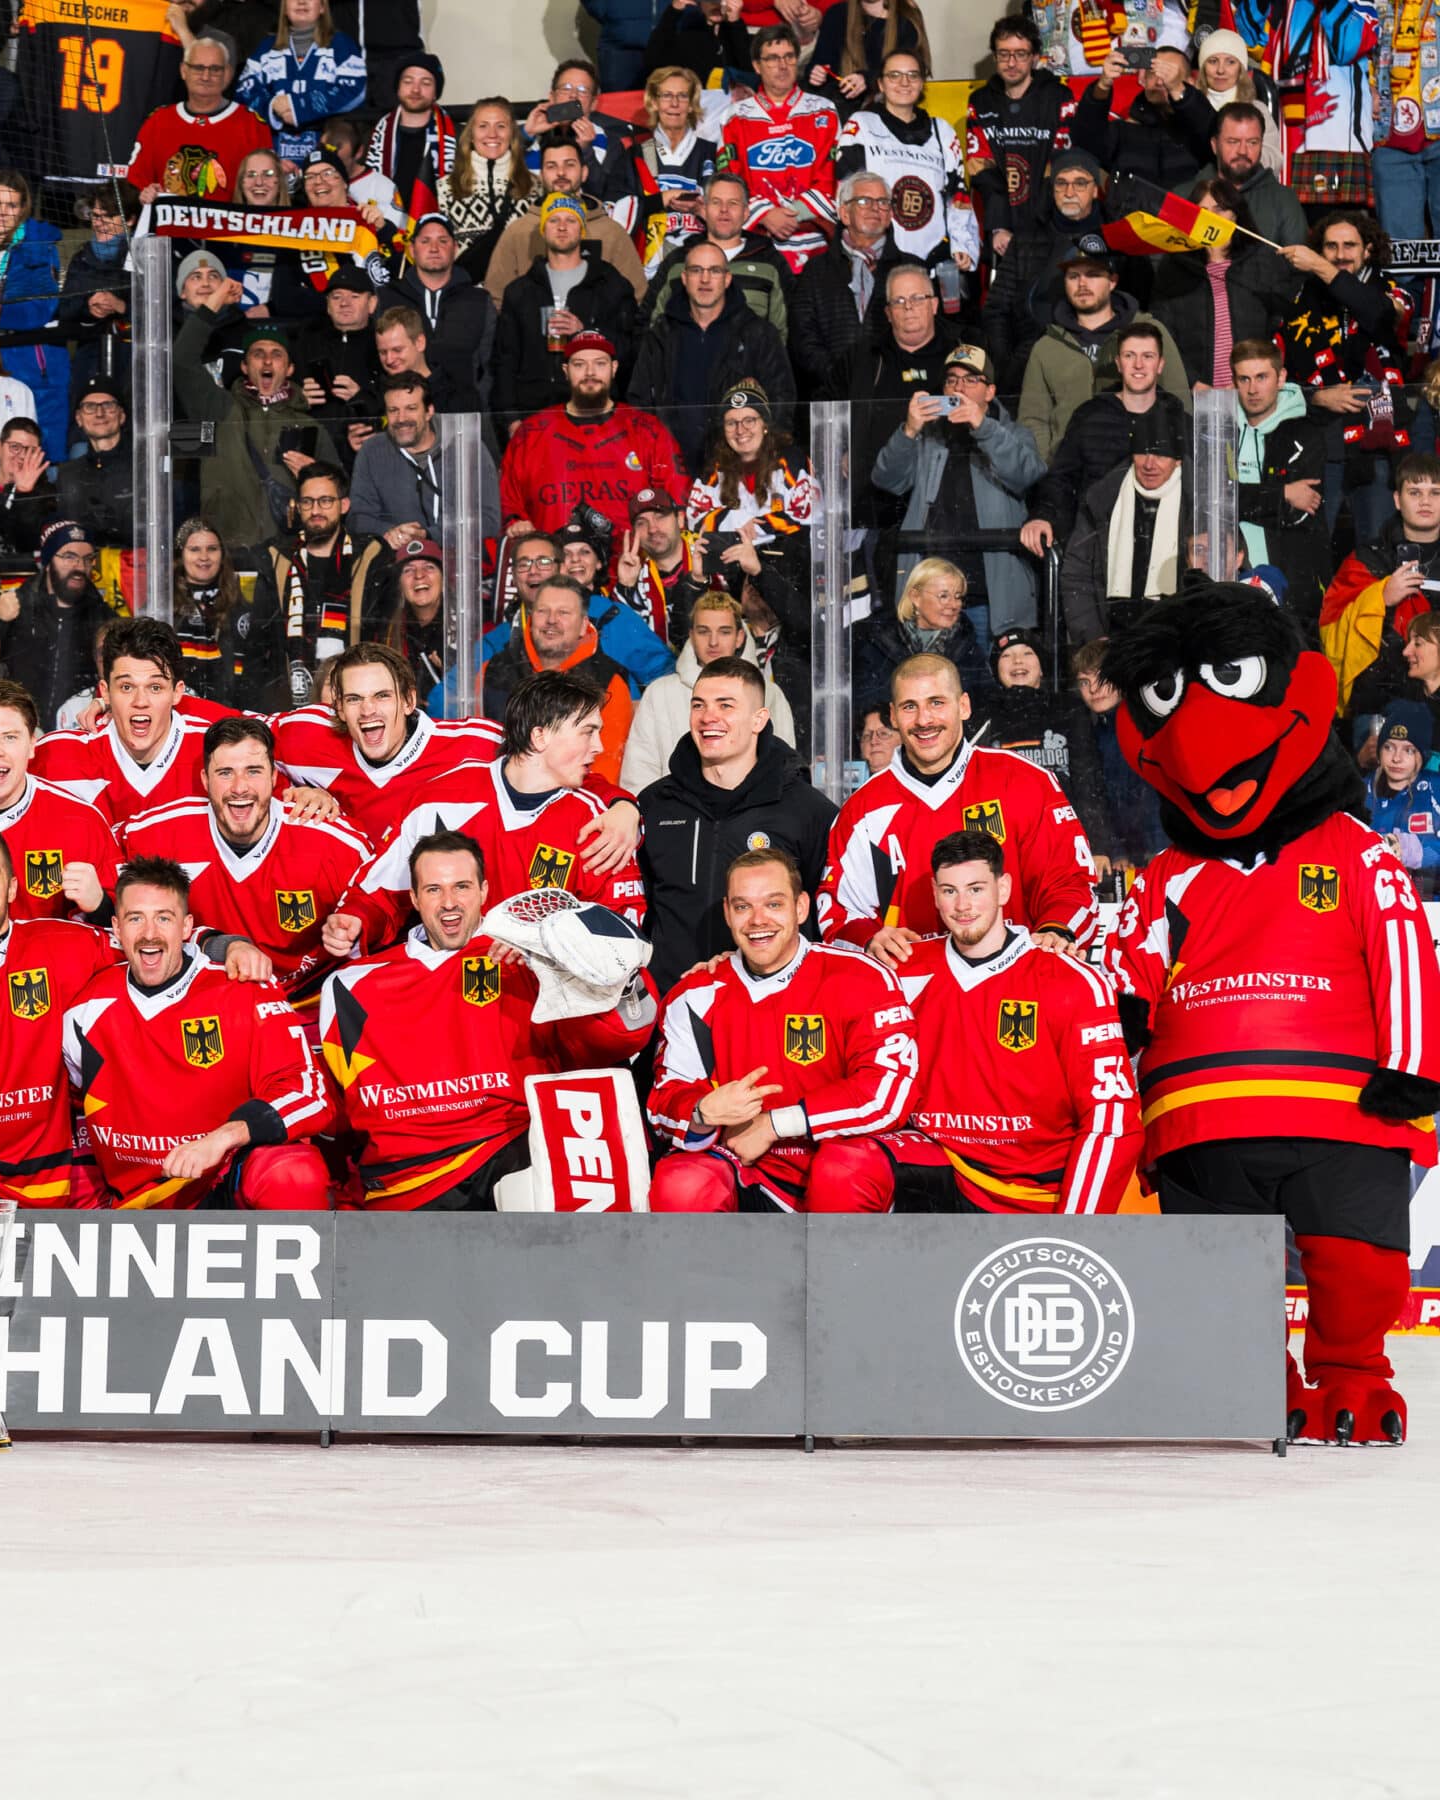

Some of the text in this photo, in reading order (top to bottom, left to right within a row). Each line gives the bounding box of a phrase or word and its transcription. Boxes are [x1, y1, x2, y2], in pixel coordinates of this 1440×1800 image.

[58, 36, 125, 113] 19
[155, 204, 357, 243] DEUTSCHLAND
[888, 833, 907, 875] A
[1171, 972, 1333, 1004] WESTMINSTER
[1185, 993, 1307, 1010] UNTERNEHMENSGRUPPE
[874, 1032, 919, 1079] 24
[360, 1072, 510, 1108] WESTMINSTER
[92, 1124, 207, 1151] WESTMINST
[907, 1111, 1034, 1131] ESTMINSTER
[978, 1247, 1109, 1290] DEUTSCHER
[489, 1320, 767, 1418] CUP
[965, 1330, 1123, 1401] EISHOCKEY-BUND
